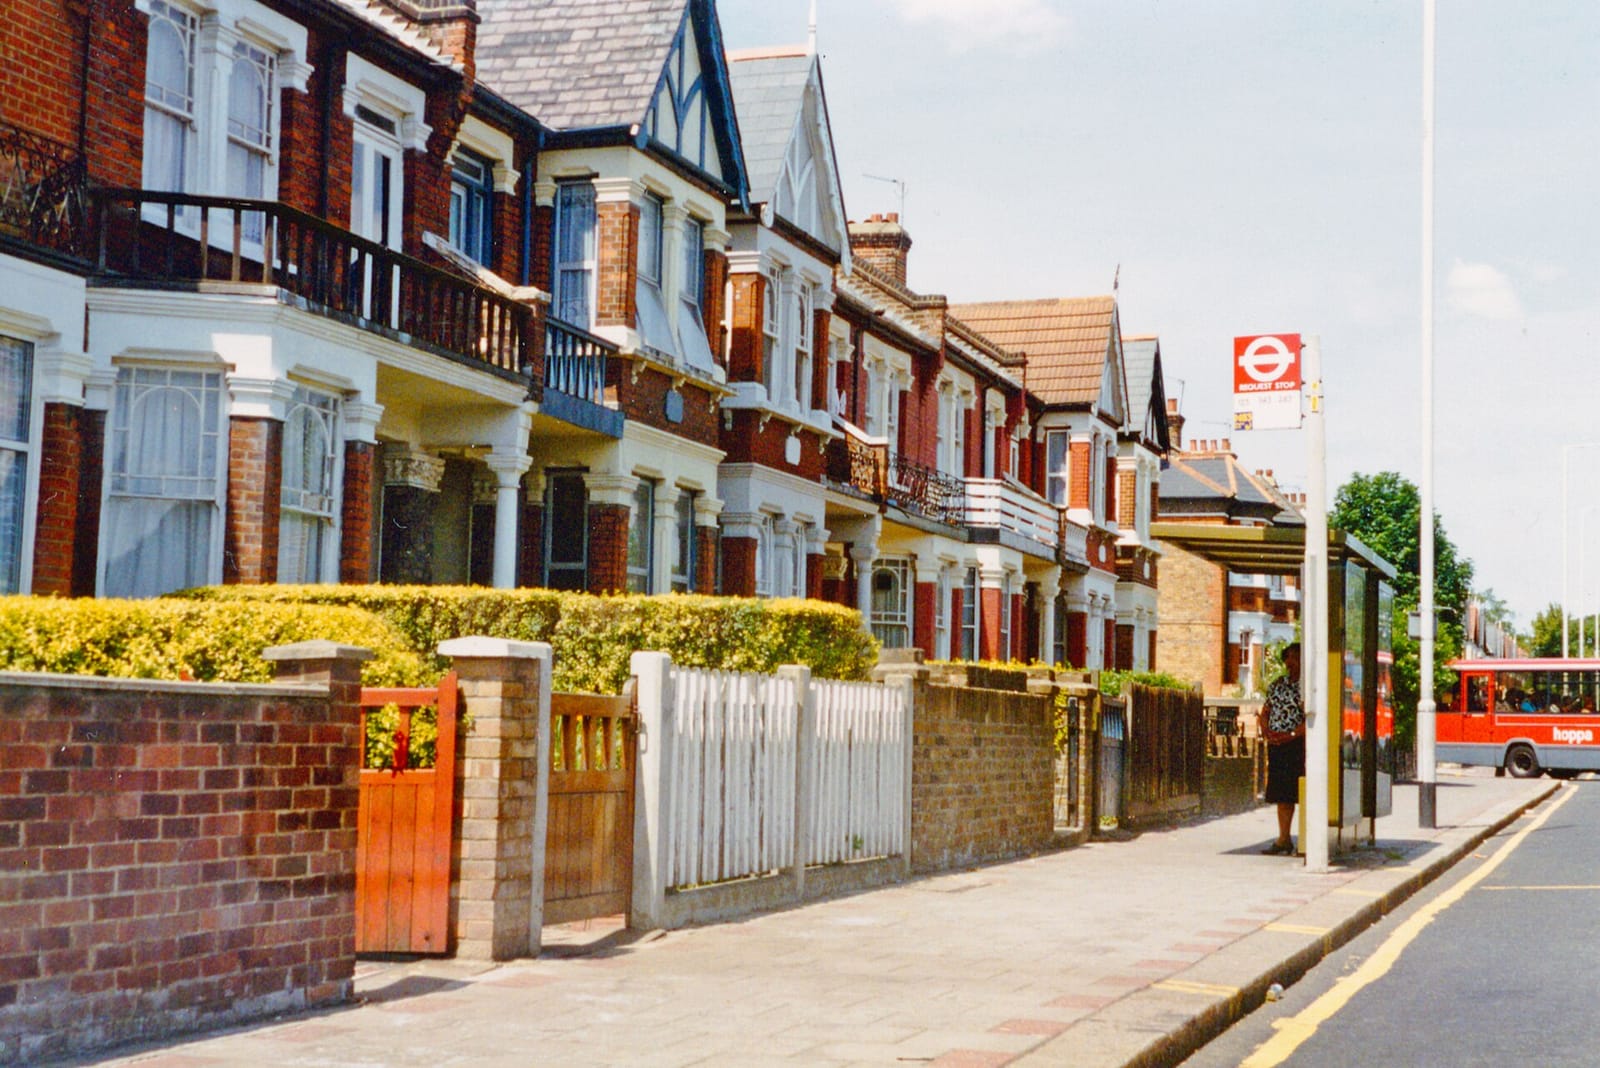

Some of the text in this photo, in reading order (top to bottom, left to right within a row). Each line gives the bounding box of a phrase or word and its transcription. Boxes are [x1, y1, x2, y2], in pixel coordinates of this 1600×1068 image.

[1239, 381, 1295, 391] REQUEST STOP
[1552, 727, 1593, 744] hoppa
